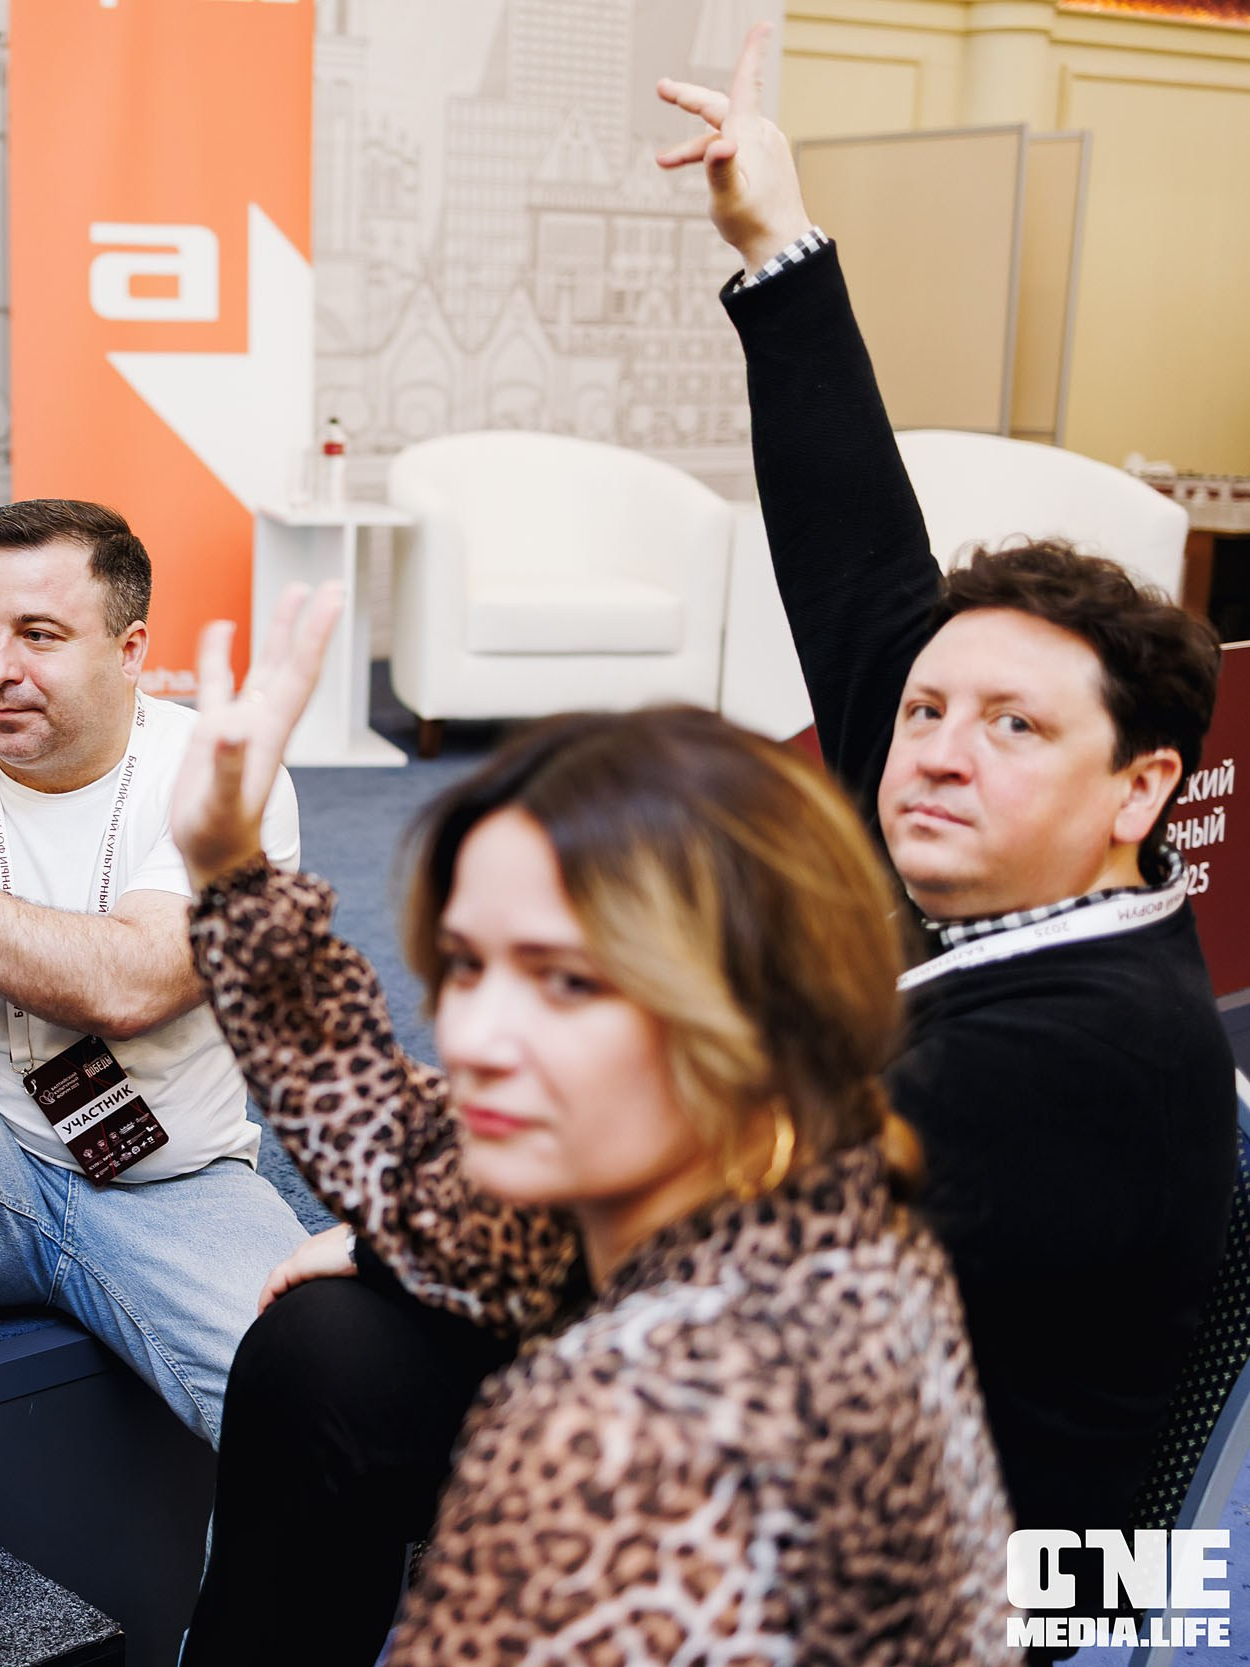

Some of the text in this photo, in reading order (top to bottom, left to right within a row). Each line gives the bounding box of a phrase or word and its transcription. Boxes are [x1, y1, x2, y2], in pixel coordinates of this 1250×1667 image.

[98, 755, 137, 914] БАЛТИЙСКИЙ КУЛЬТУРНЫЙ
[84, 1055, 114, 1079] ПОБЕДЫ
[61, 1083, 135, 1135] УЧАСТНИК
